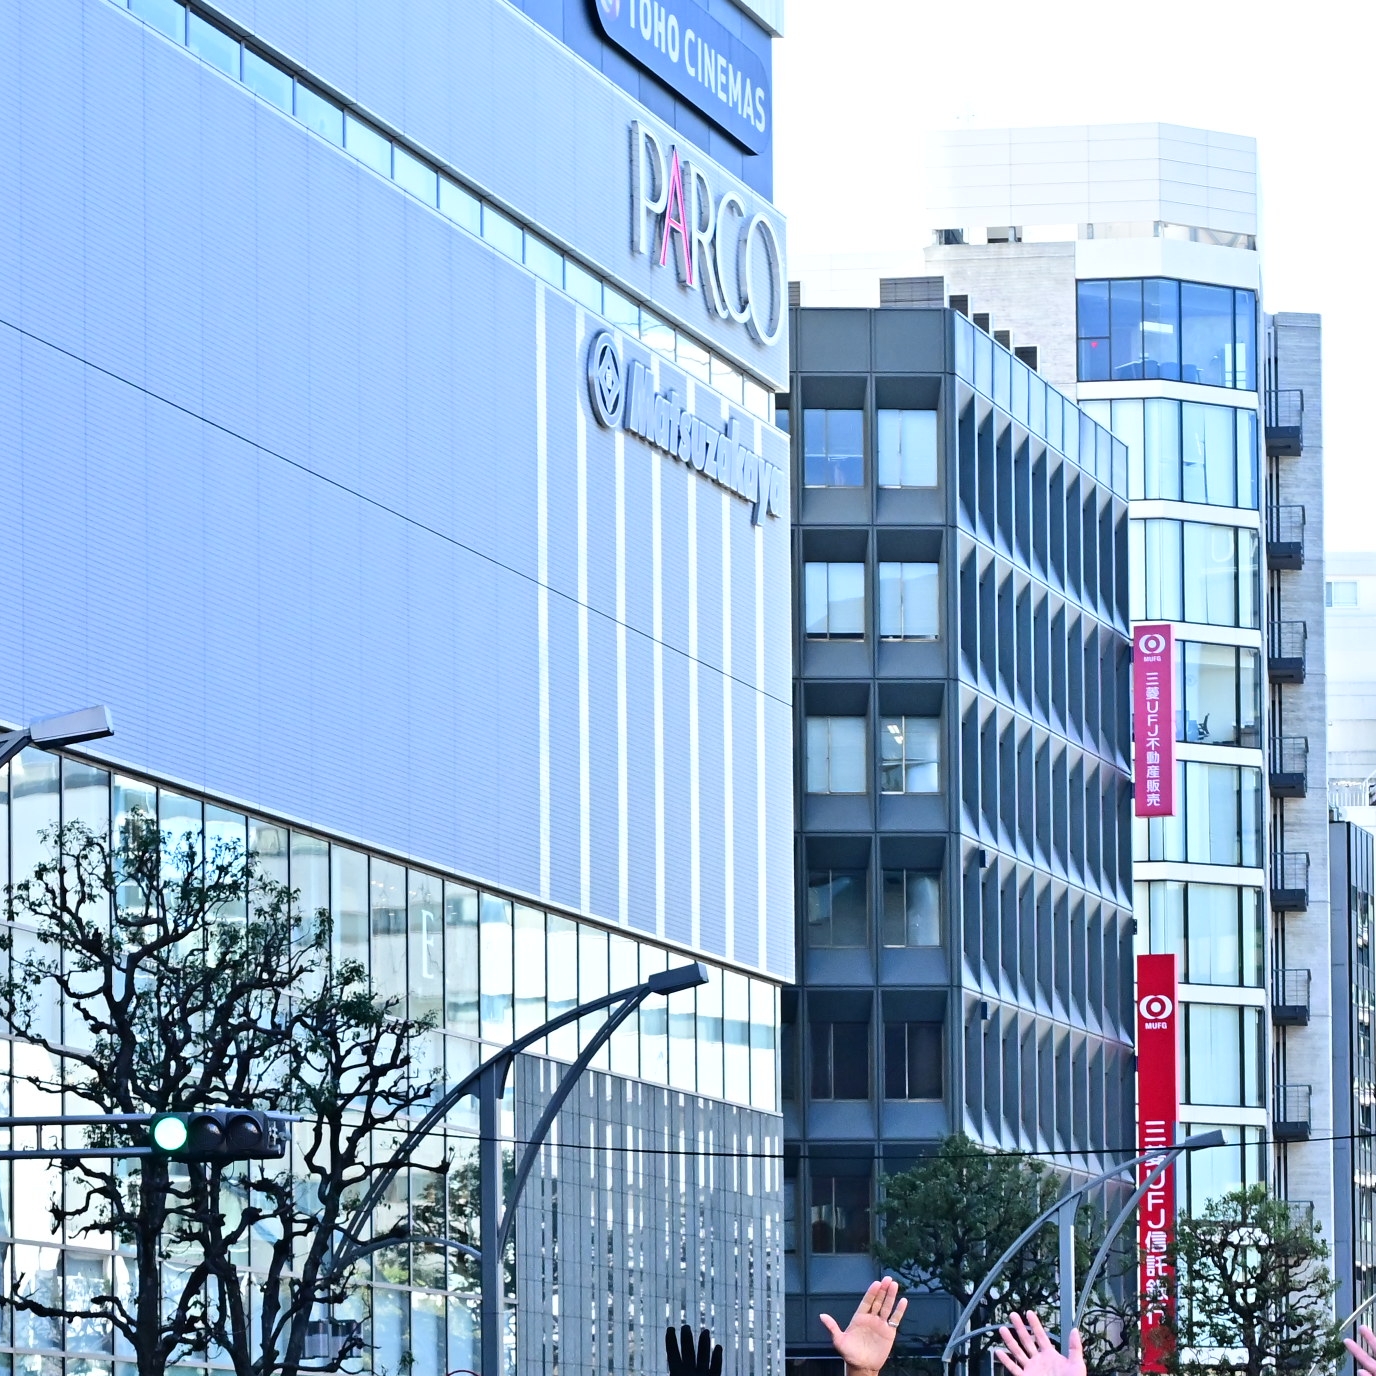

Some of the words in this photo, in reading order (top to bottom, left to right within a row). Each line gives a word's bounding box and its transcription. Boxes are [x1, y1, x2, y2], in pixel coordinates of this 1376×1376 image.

[684, 27, 767, 134] CINEMAS
[631, 119, 786, 348] PARCO
[625, 358, 783, 527] Matsuzakaya
[1145, 671, 1161, 807] 三菱UFJ不動産販売
